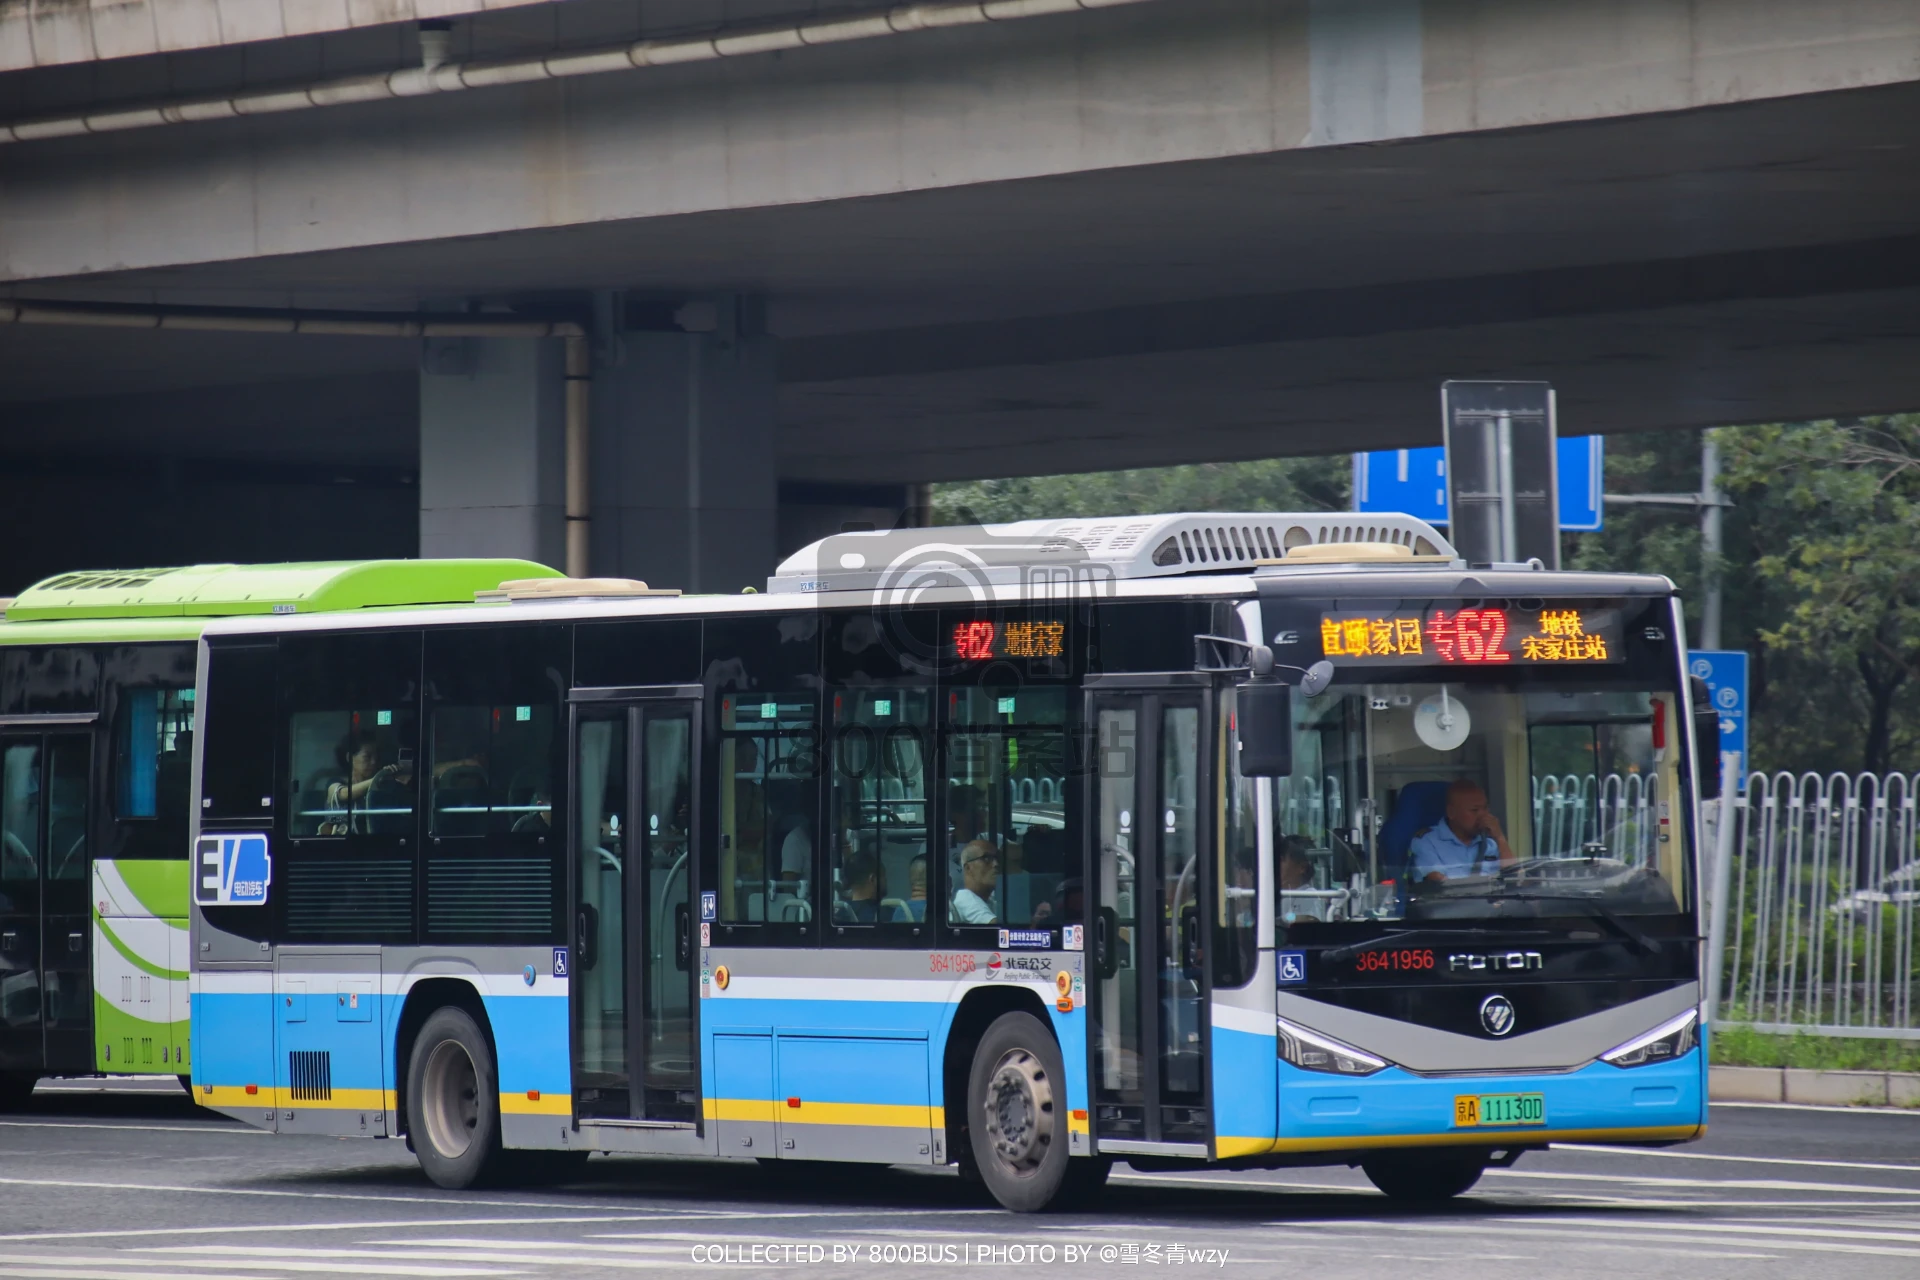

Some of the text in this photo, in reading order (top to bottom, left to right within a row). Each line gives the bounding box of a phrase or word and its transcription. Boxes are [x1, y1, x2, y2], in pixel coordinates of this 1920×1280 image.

[1539, 611, 1584, 636] 地铁
[1521, 636, 1607, 660] 宋家庄站
[234, 880, 263, 896] 电动汽车
[929, 954, 976, 973] 3641956
[1005, 957, 1052, 970] 北京公交
[1356, 949, 1434, 971] 3641956
[1449, 952, 1543, 971] FOTON
